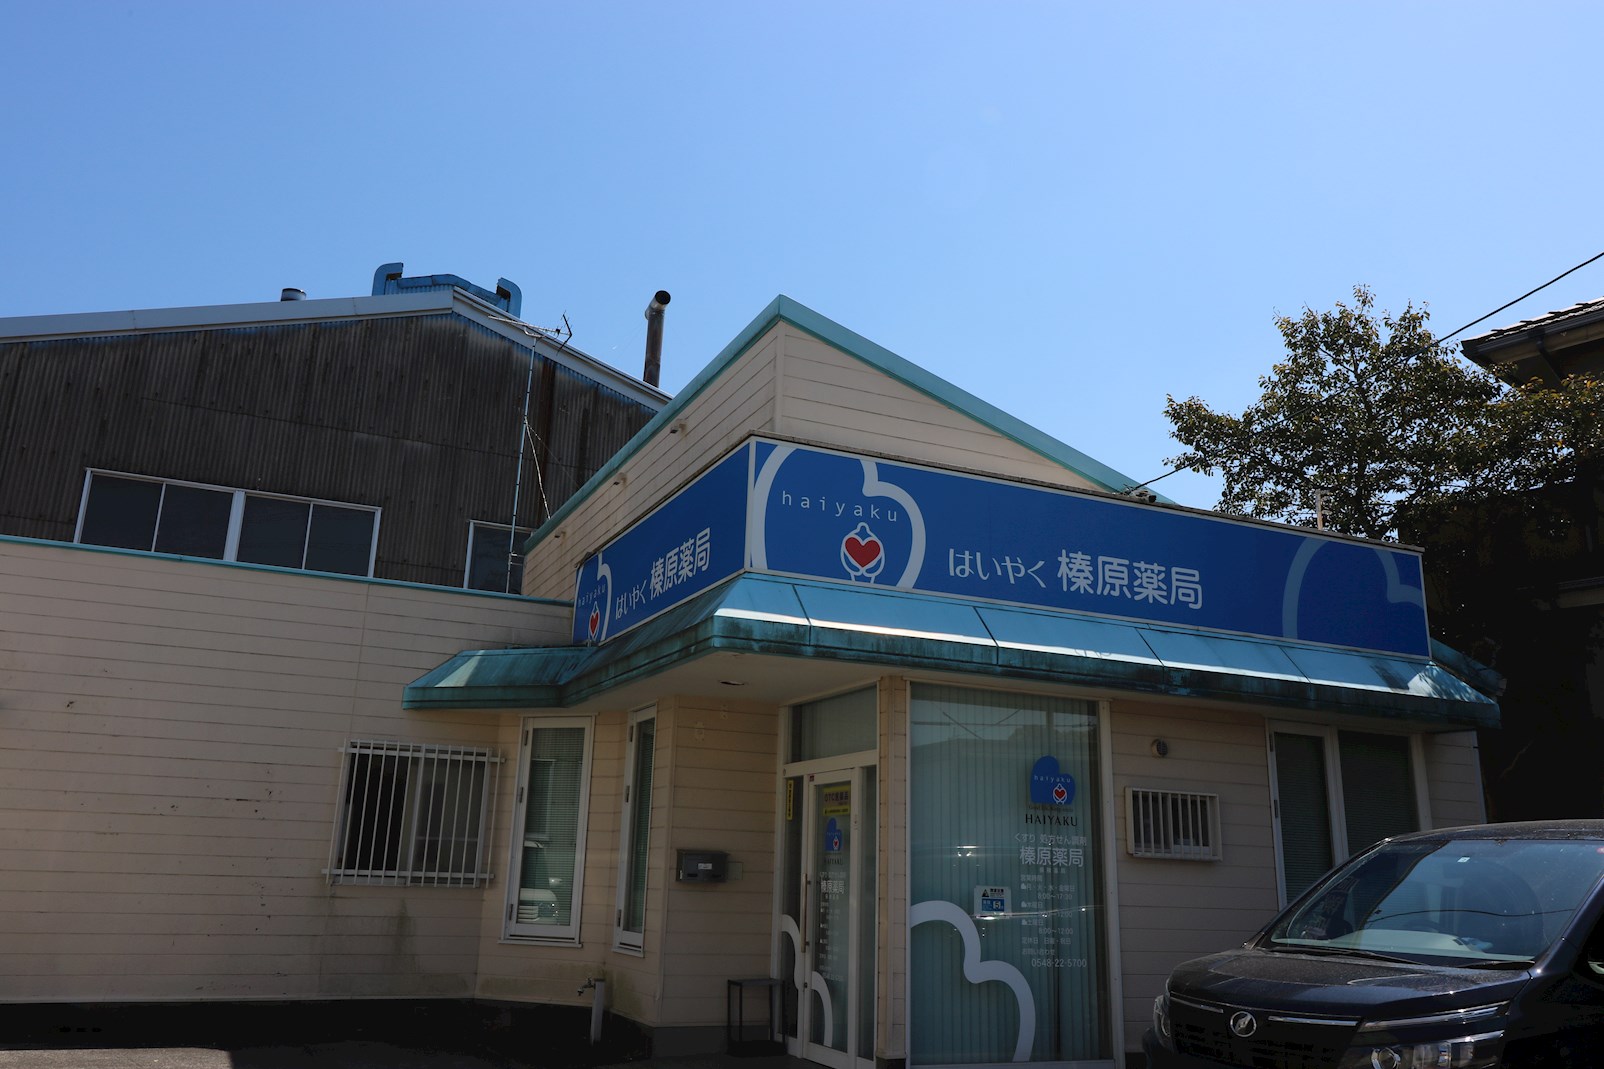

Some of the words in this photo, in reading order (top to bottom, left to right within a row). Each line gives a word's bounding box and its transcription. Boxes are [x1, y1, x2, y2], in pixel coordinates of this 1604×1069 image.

[782, 490, 898, 522] haiyaku
[615, 579, 647, 620] はいやく
[650, 527, 711, 600] 榛原薬局
[949, 548, 1046, 588] はいやく
[1057, 549, 1203, 610] 榛原薬局
[578, 583, 606, 608] haiyaku
[1033, 775, 1071, 783] haiyaku
[1025, 813, 1078, 827] HAIYAKU
[1015, 832, 1036, 843] くすり
[1019, 845, 1084, 868] 榛原薬局
[1031, 958, 1087, 968] 0548-22-5700
